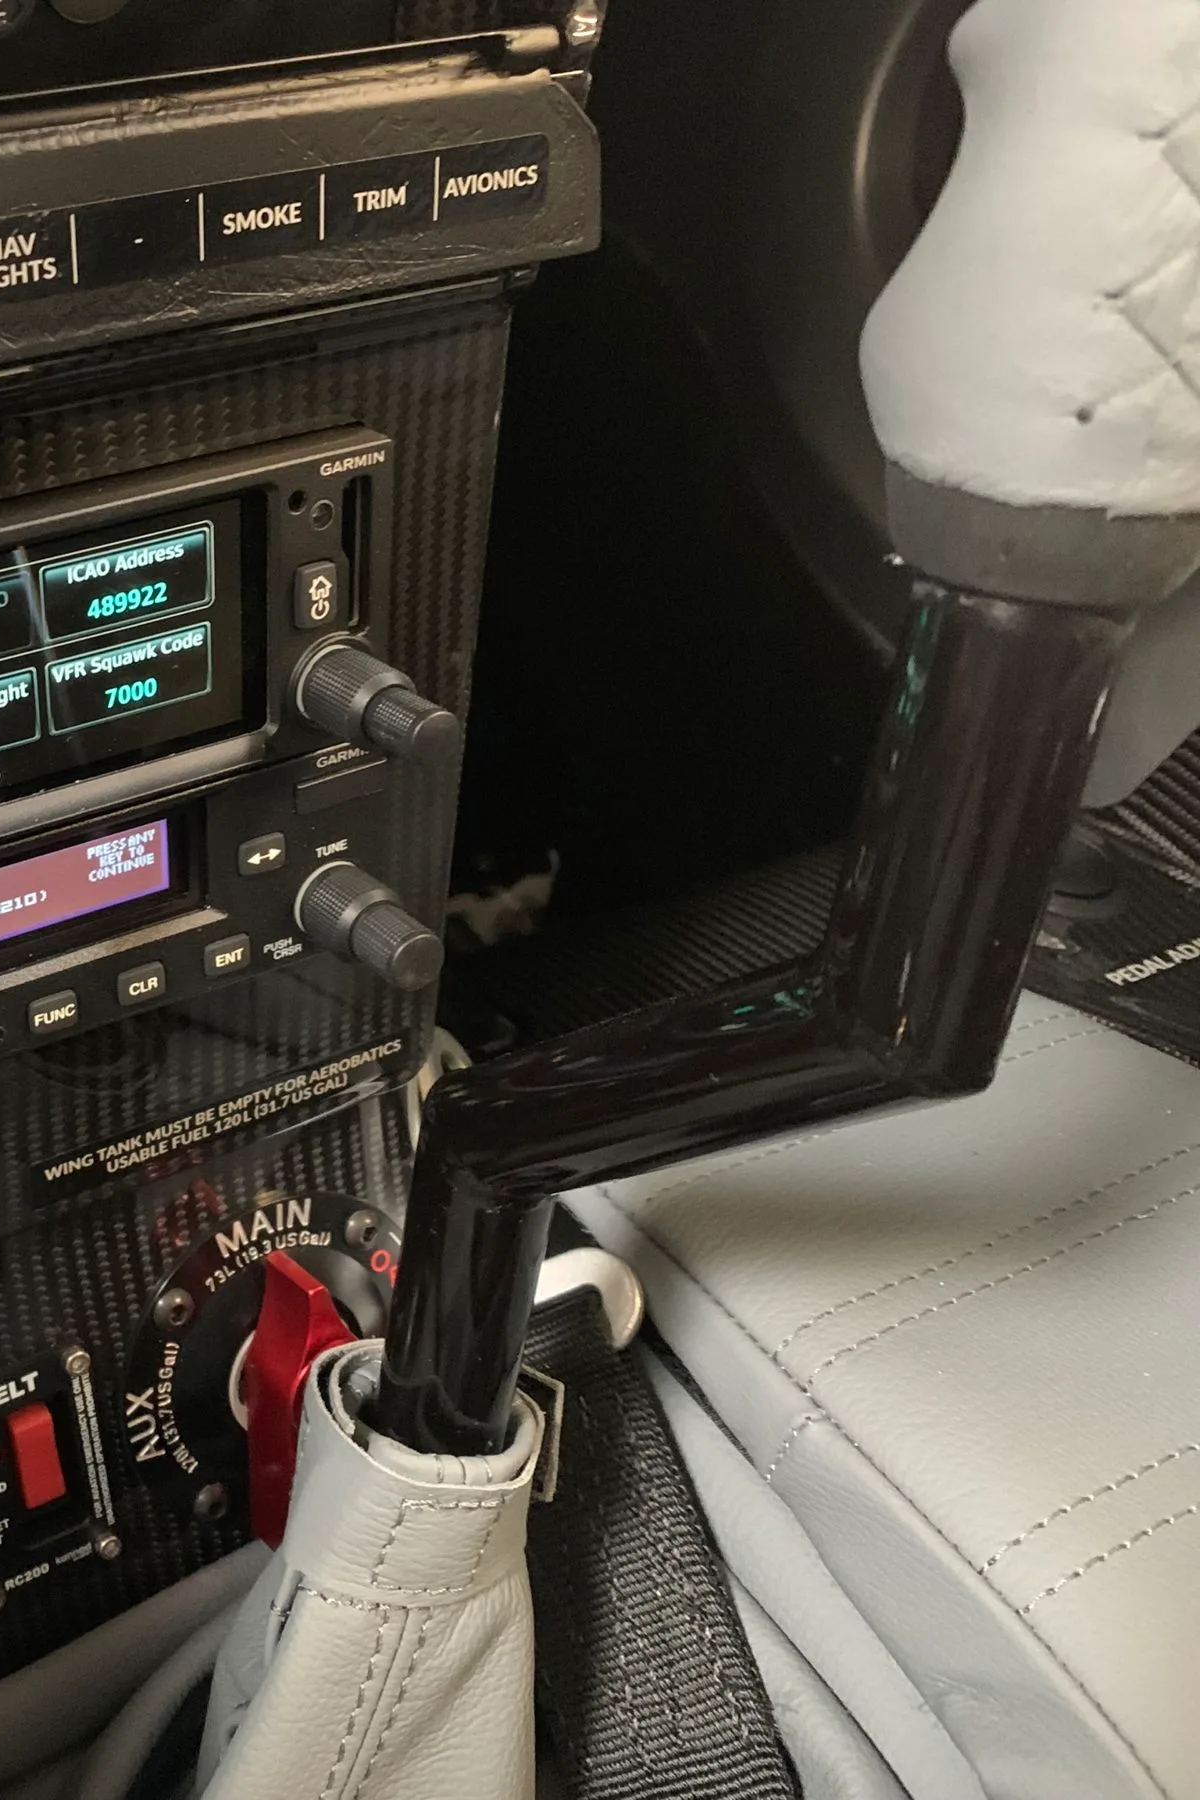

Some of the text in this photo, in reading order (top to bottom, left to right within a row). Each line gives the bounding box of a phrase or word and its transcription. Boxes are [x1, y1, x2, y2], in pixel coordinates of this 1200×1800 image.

[443, 165, 538, 199] AVIONICS
[354, 185, 407, 213] TRIM
[222, 202, 302, 236] SMOKE
[320, 450, 385, 476] GARMIN
[67, 542, 185, 585] ICAO Address
[86, 581, 168, 621] 489922
[52, 630, 204, 685] VFR Squawk Code
[104, 677, 158, 709] 7000
[316, 747, 369, 768] GARM
[86, 829, 156, 860] PRESS ANY
[99, 845, 145, 868] KEY TO
[315, 838, 349, 859] TUNE
[88, 853, 155, 882] CONTINUE
[215, 947, 244, 968] ENT
[263, 936, 293, 955] PUSH
[273, 943, 303, 961] CRSR
[1104, 937, 1200, 986] PEDAL AD
[128, 976, 159, 996] CLR
[33, 1002, 77, 1028] FUNC
[44, 1038, 402, 1182] WING TANK MUST BE EMPTY FOR AEROBATICS
[106, 1140, 170, 1174] USABLE
[171, 1126, 212, 1152] FUEL
[253, 1094, 290, 1119] (31.7
[291, 1088, 313, 1104] US
[313, 1072, 349, 1096] GAL)
[215, 1198, 312, 1259] MAIN
[205, 1230, 332, 1293] 73L (19.3 US Gal)
[159, 1342, 181, 1379] Gal)
[71, 1376, 81, 1394] ONL
[157, 1381, 173, 1408] US
[126, 1387, 166, 1463] AUX
[4, 1563, 50, 1591] RC200
